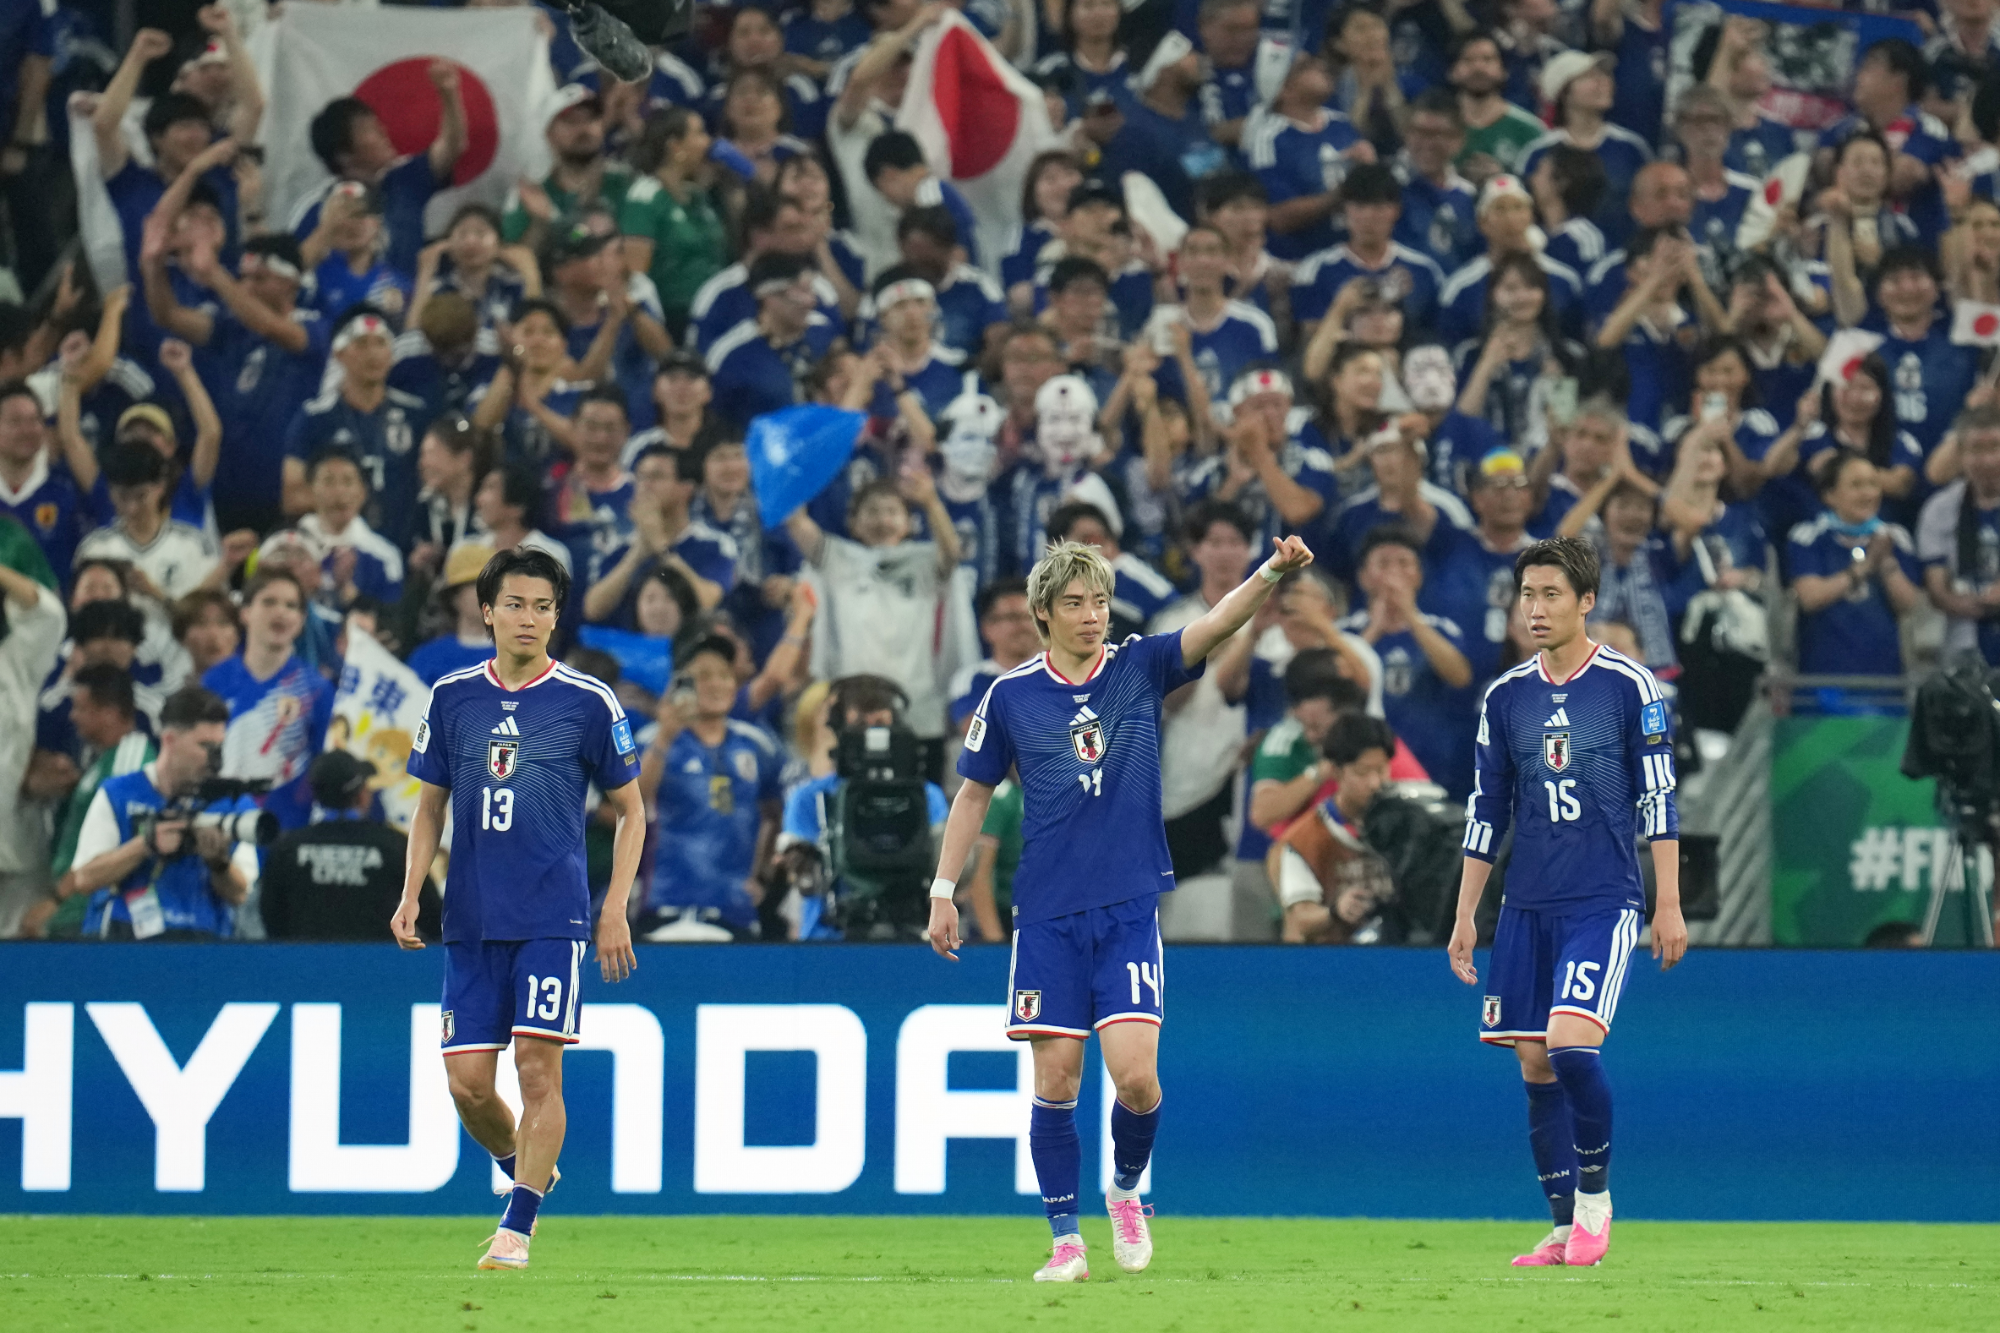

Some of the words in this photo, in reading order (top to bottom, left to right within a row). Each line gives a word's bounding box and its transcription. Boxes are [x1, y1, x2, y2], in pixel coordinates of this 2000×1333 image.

[482, 787, 515, 832] 13
[1544, 779, 1581, 823] 15
[526, 974, 562, 1021] 13
[1126, 961, 1160, 1008] 14
[1561, 960, 1601, 1001] 15
